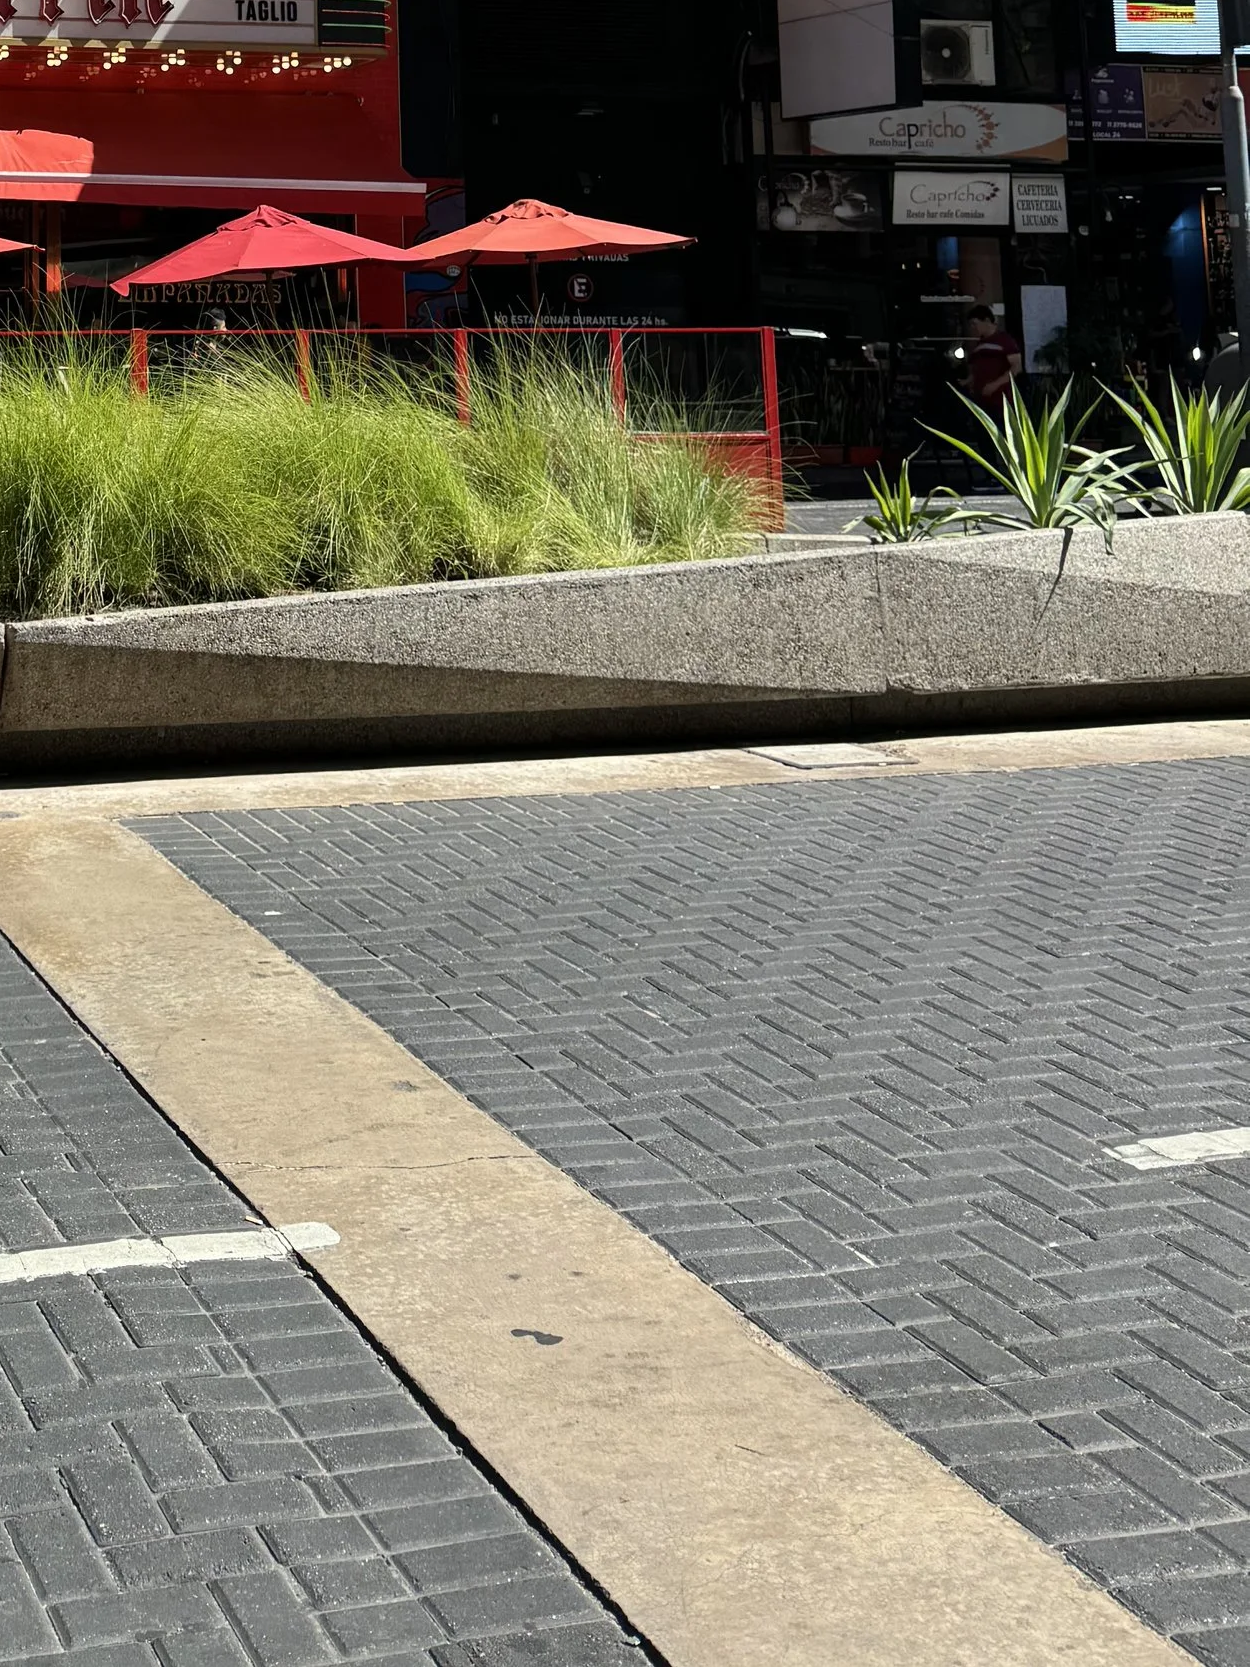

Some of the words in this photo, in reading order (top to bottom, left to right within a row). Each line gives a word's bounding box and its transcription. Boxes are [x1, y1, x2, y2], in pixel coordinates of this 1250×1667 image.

[235, 0, 298, 22] TAGLIO
[878, 109, 966, 150] Capricho
[910, 182, 986, 207] Capricho
[1017, 184, 1059, 197] CAFETERIA
[1016, 199, 1062, 212] CERVECERIA
[955, 209, 985, 219] Comidas
[1021, 214, 1059, 227] LICUADOS
[117, 282, 282, 305] MPANADAS
[510, 314, 571, 325] ESTAIONAR
[572, 315, 618, 326] DURANTE
[620, 315, 639, 326] LAS
[641, 315, 653, 326] 24
